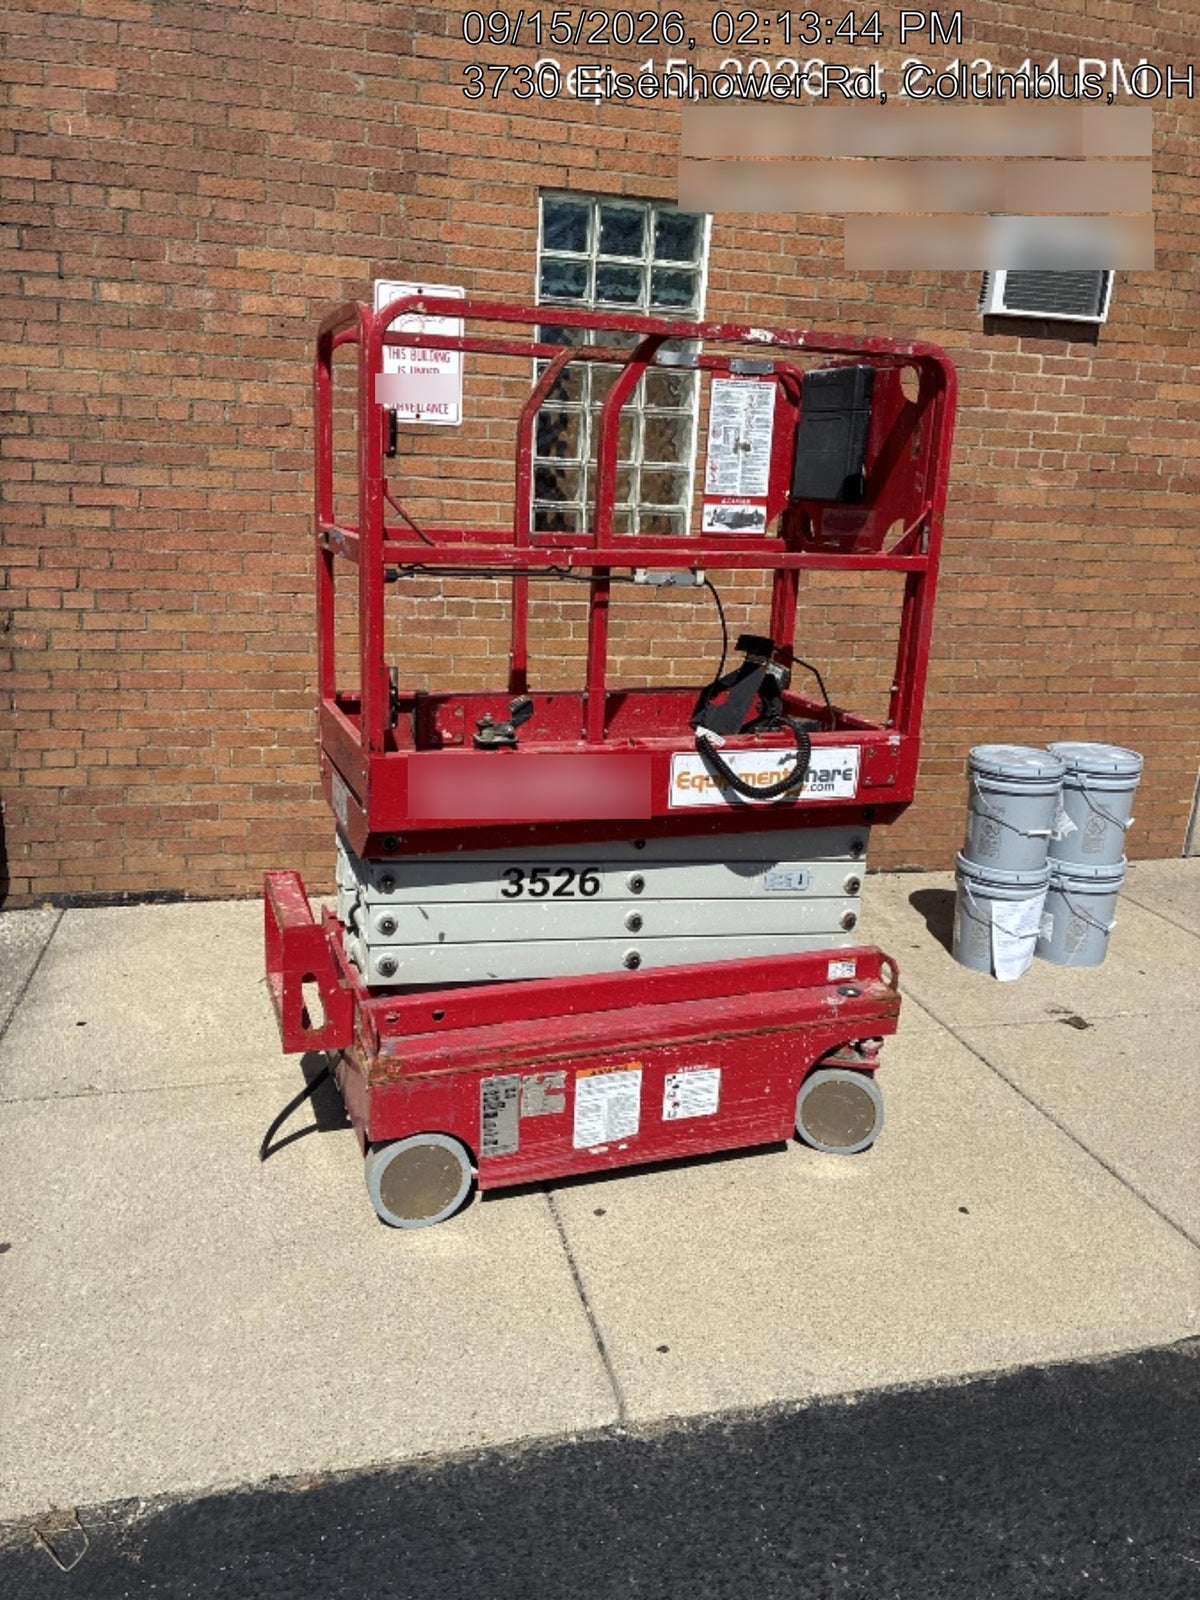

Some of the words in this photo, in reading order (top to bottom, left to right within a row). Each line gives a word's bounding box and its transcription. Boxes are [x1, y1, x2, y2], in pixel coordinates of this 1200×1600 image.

[388, 346, 406, 360] THIS
[410, 348, 451, 363] BUILDING
[807, 783, 835, 792] .com
[501, 867, 600, 898] 3526
